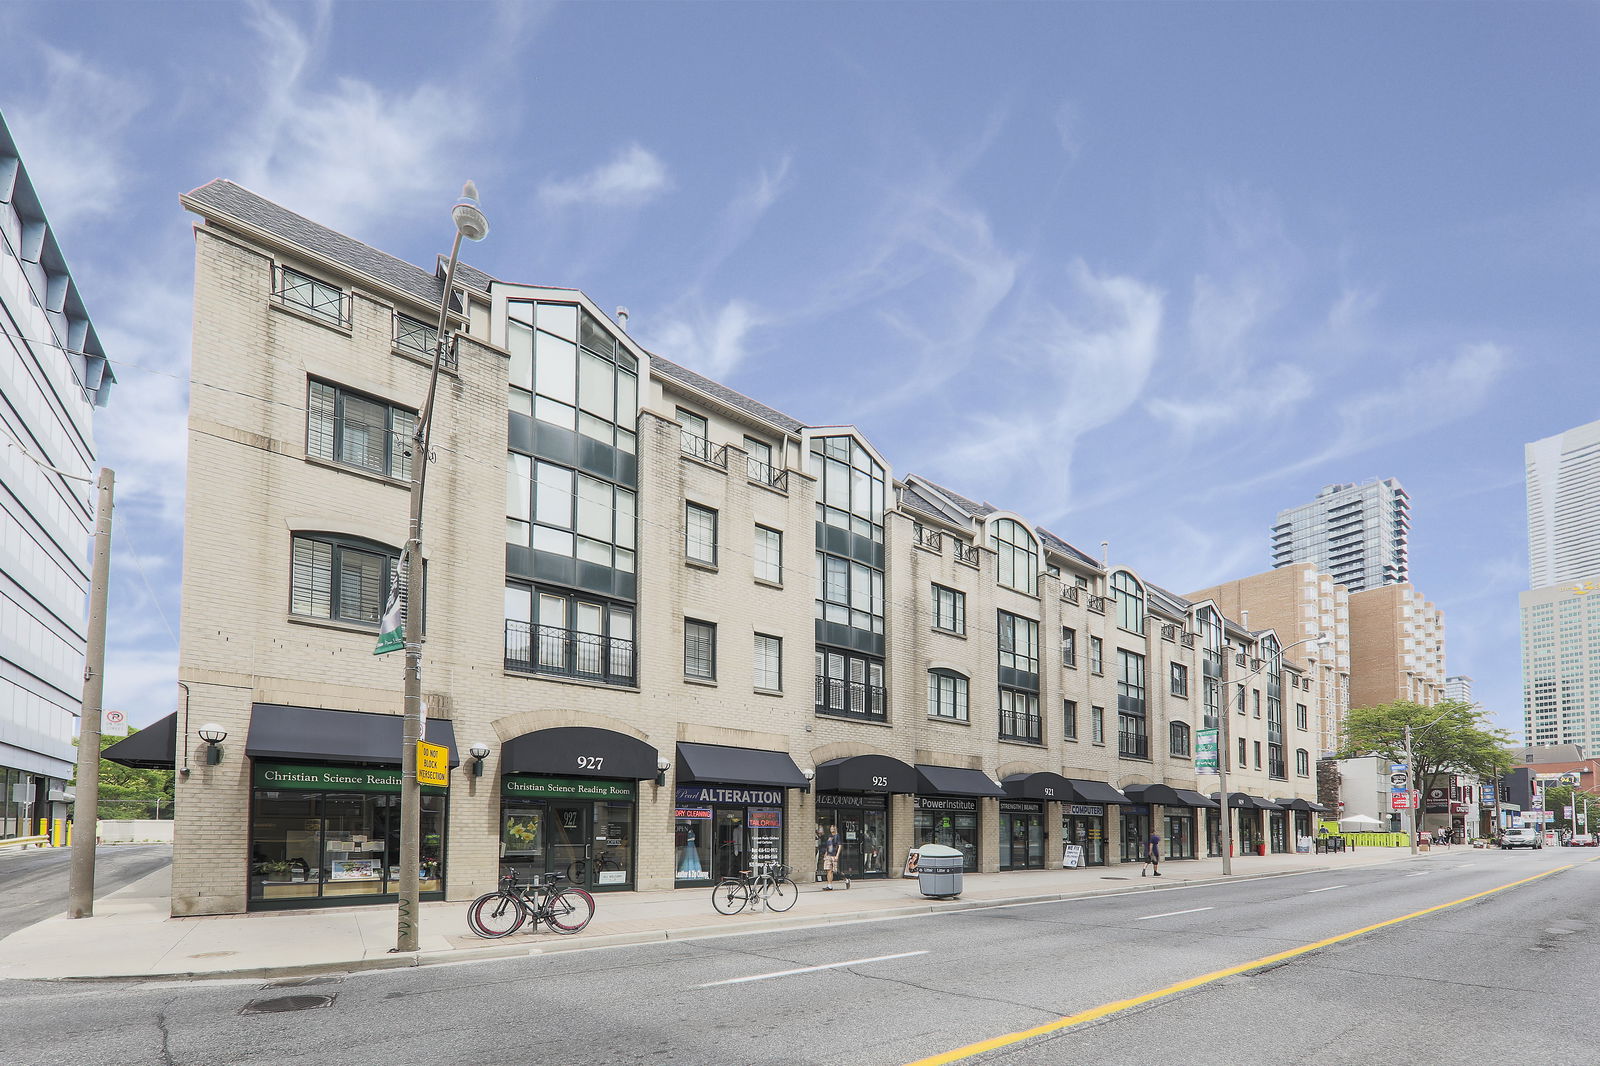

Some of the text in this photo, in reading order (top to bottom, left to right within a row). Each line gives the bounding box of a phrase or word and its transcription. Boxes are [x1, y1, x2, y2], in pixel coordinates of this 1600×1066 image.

[423, 747, 438, 758] DO NOT
[423, 759, 437, 769] BLOCK
[577, 756, 604, 770] 927
[264, 770, 402, 785] Christian Science Readin
[872, 776, 888, 787] 925
[507, 781, 630, 795] Christian Science Reading Room
[1044, 787, 1054, 796] 921
[700, 788, 782, 804] ALTERATION
[816, 795, 863, 806] ALEXANDRA
[922, 799, 975, 810] PowerInstitute
[1071, 805, 1103, 815] COMPUTERS
[564, 812, 577, 825] 927
[675, 809, 711, 818] DRY CLEANING
[749, 819, 780, 827] TAILORING
[846, 821, 855, 831] 925
